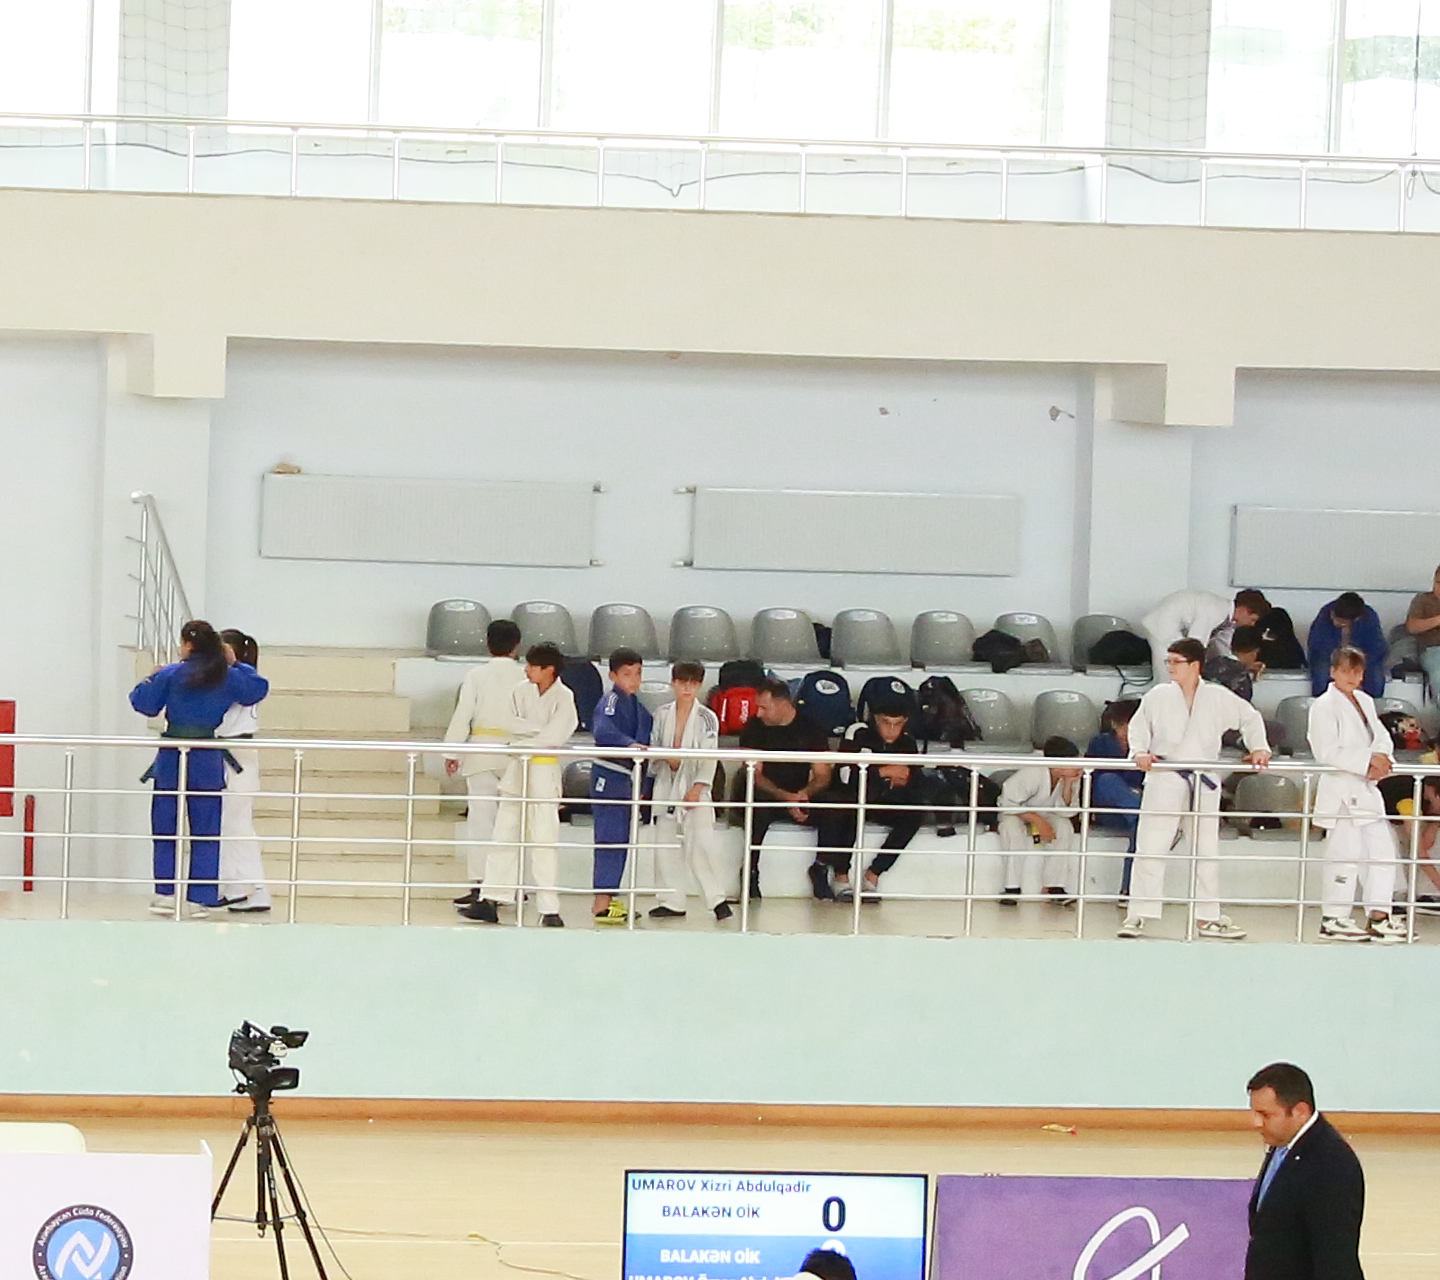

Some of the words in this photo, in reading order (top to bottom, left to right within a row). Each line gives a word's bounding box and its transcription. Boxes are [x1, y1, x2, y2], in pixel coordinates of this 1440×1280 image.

[631, 1179, 696, 1191] UMAROV
[700, 1179, 732, 1191] Xizri
[736, 1180, 812, 1195] Abdulqadir
[662, 1205, 732, 1218] BALAKƏN
[822, 1195, 846, 1232] 0
[660, 1248, 730, 1264] BALAKƏN
